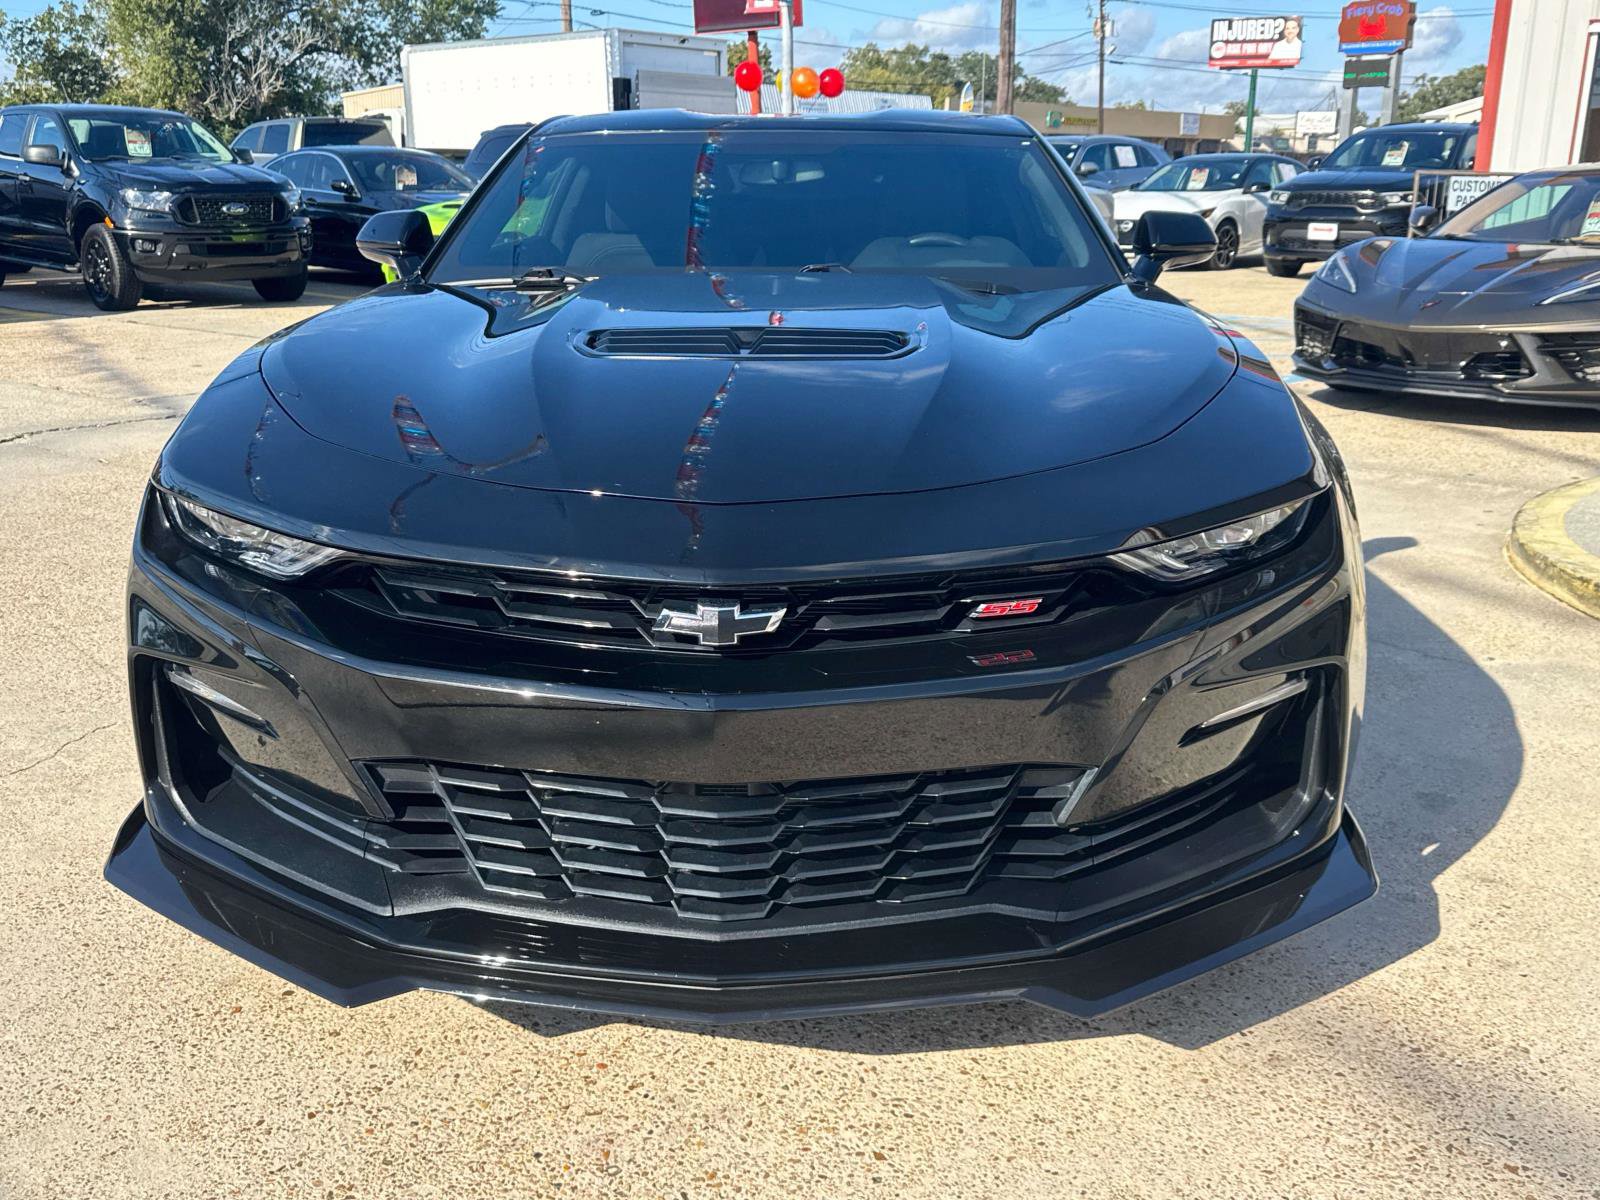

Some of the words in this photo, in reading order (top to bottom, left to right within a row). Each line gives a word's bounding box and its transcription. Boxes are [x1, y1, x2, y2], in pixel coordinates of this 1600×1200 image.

[1376, 3, 1403, 16] Crab
[1212, 18, 1285, 41] INJURED?
[969, 598, 1043, 618] SS
